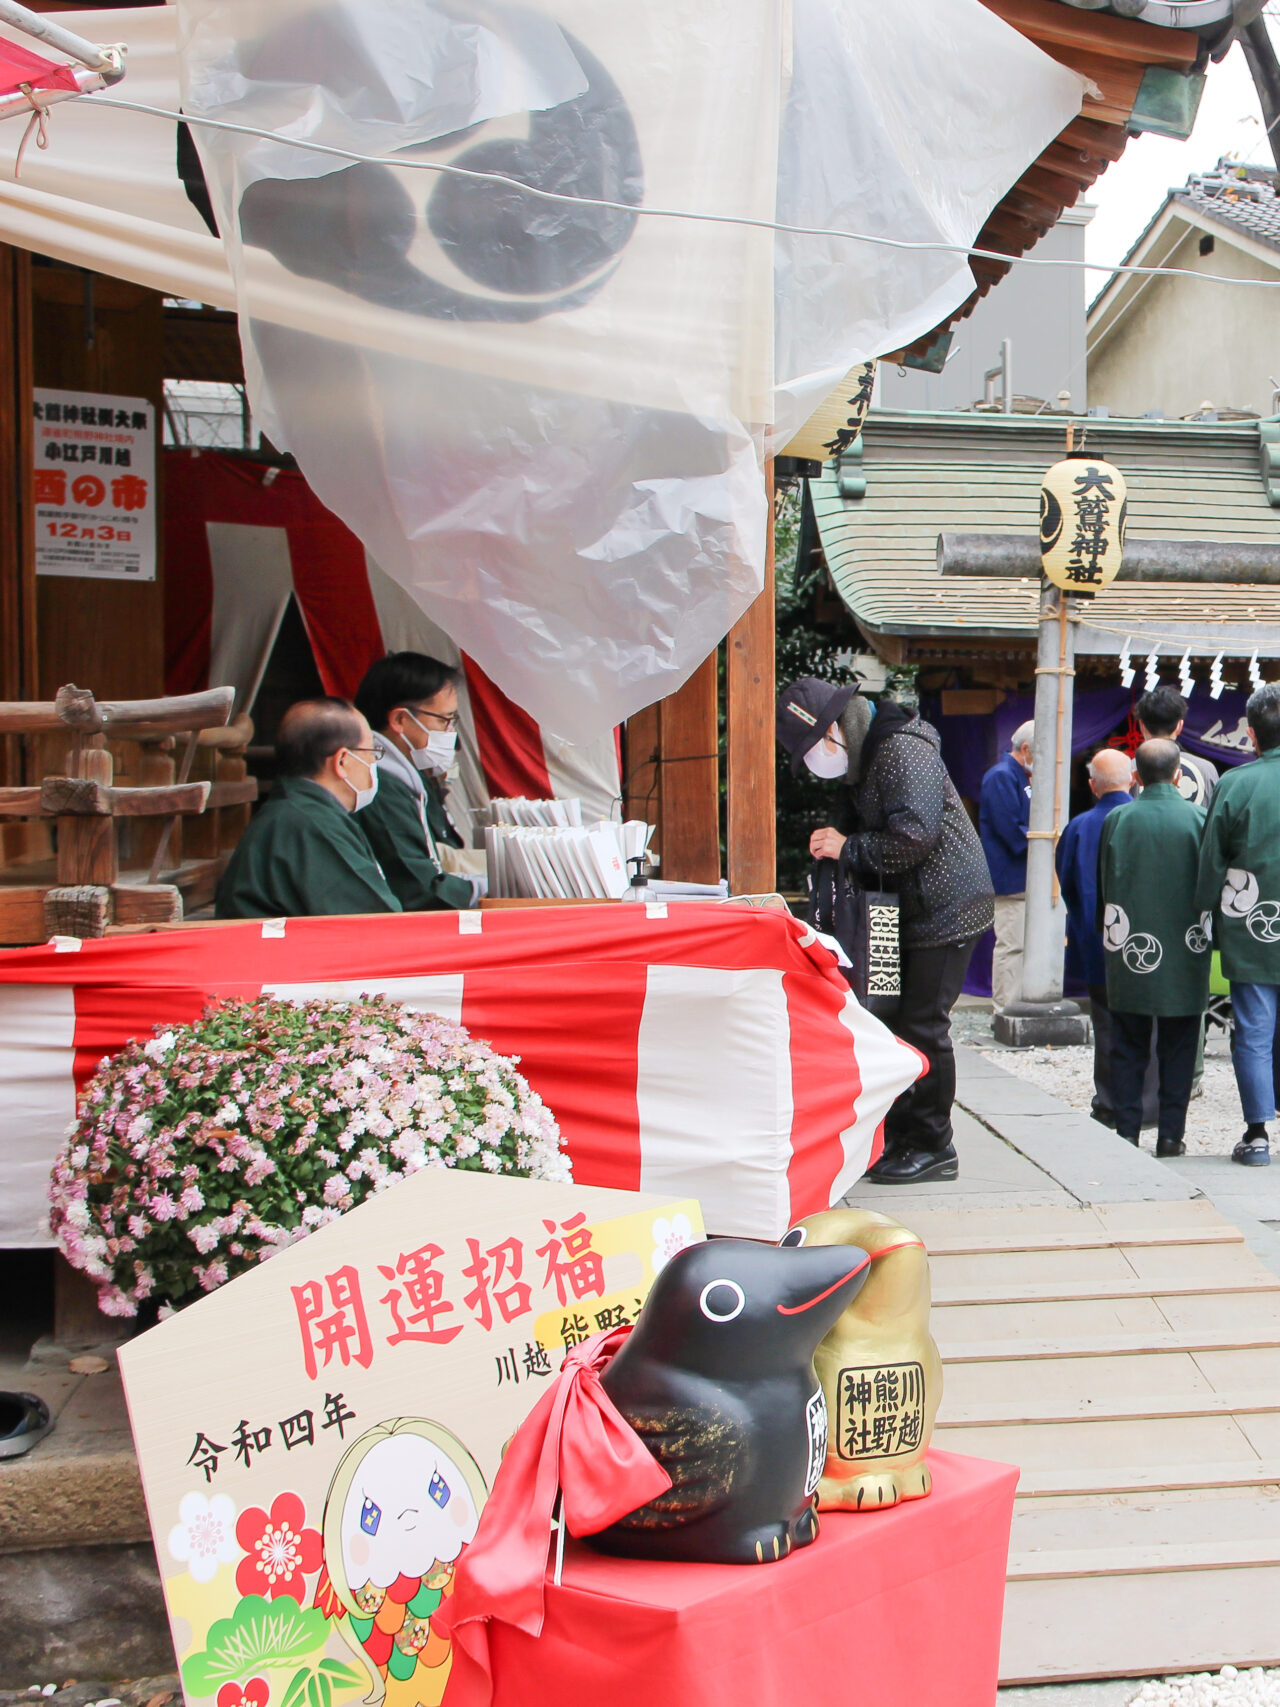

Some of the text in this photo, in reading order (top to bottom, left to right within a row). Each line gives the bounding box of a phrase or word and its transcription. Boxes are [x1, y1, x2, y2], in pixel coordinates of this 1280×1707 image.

[45, 441, 131, 467] 小江戸川越
[33, 468, 148, 512] 酉の市
[46, 522, 131, 542] 12月3日
[1065, 467, 1116, 585] 大鷲神社
[289, 1211, 605, 1381] 開運招福
[495, 1340, 552, 1387] 川越
[185, 1392, 357, 1484] 令和四年
